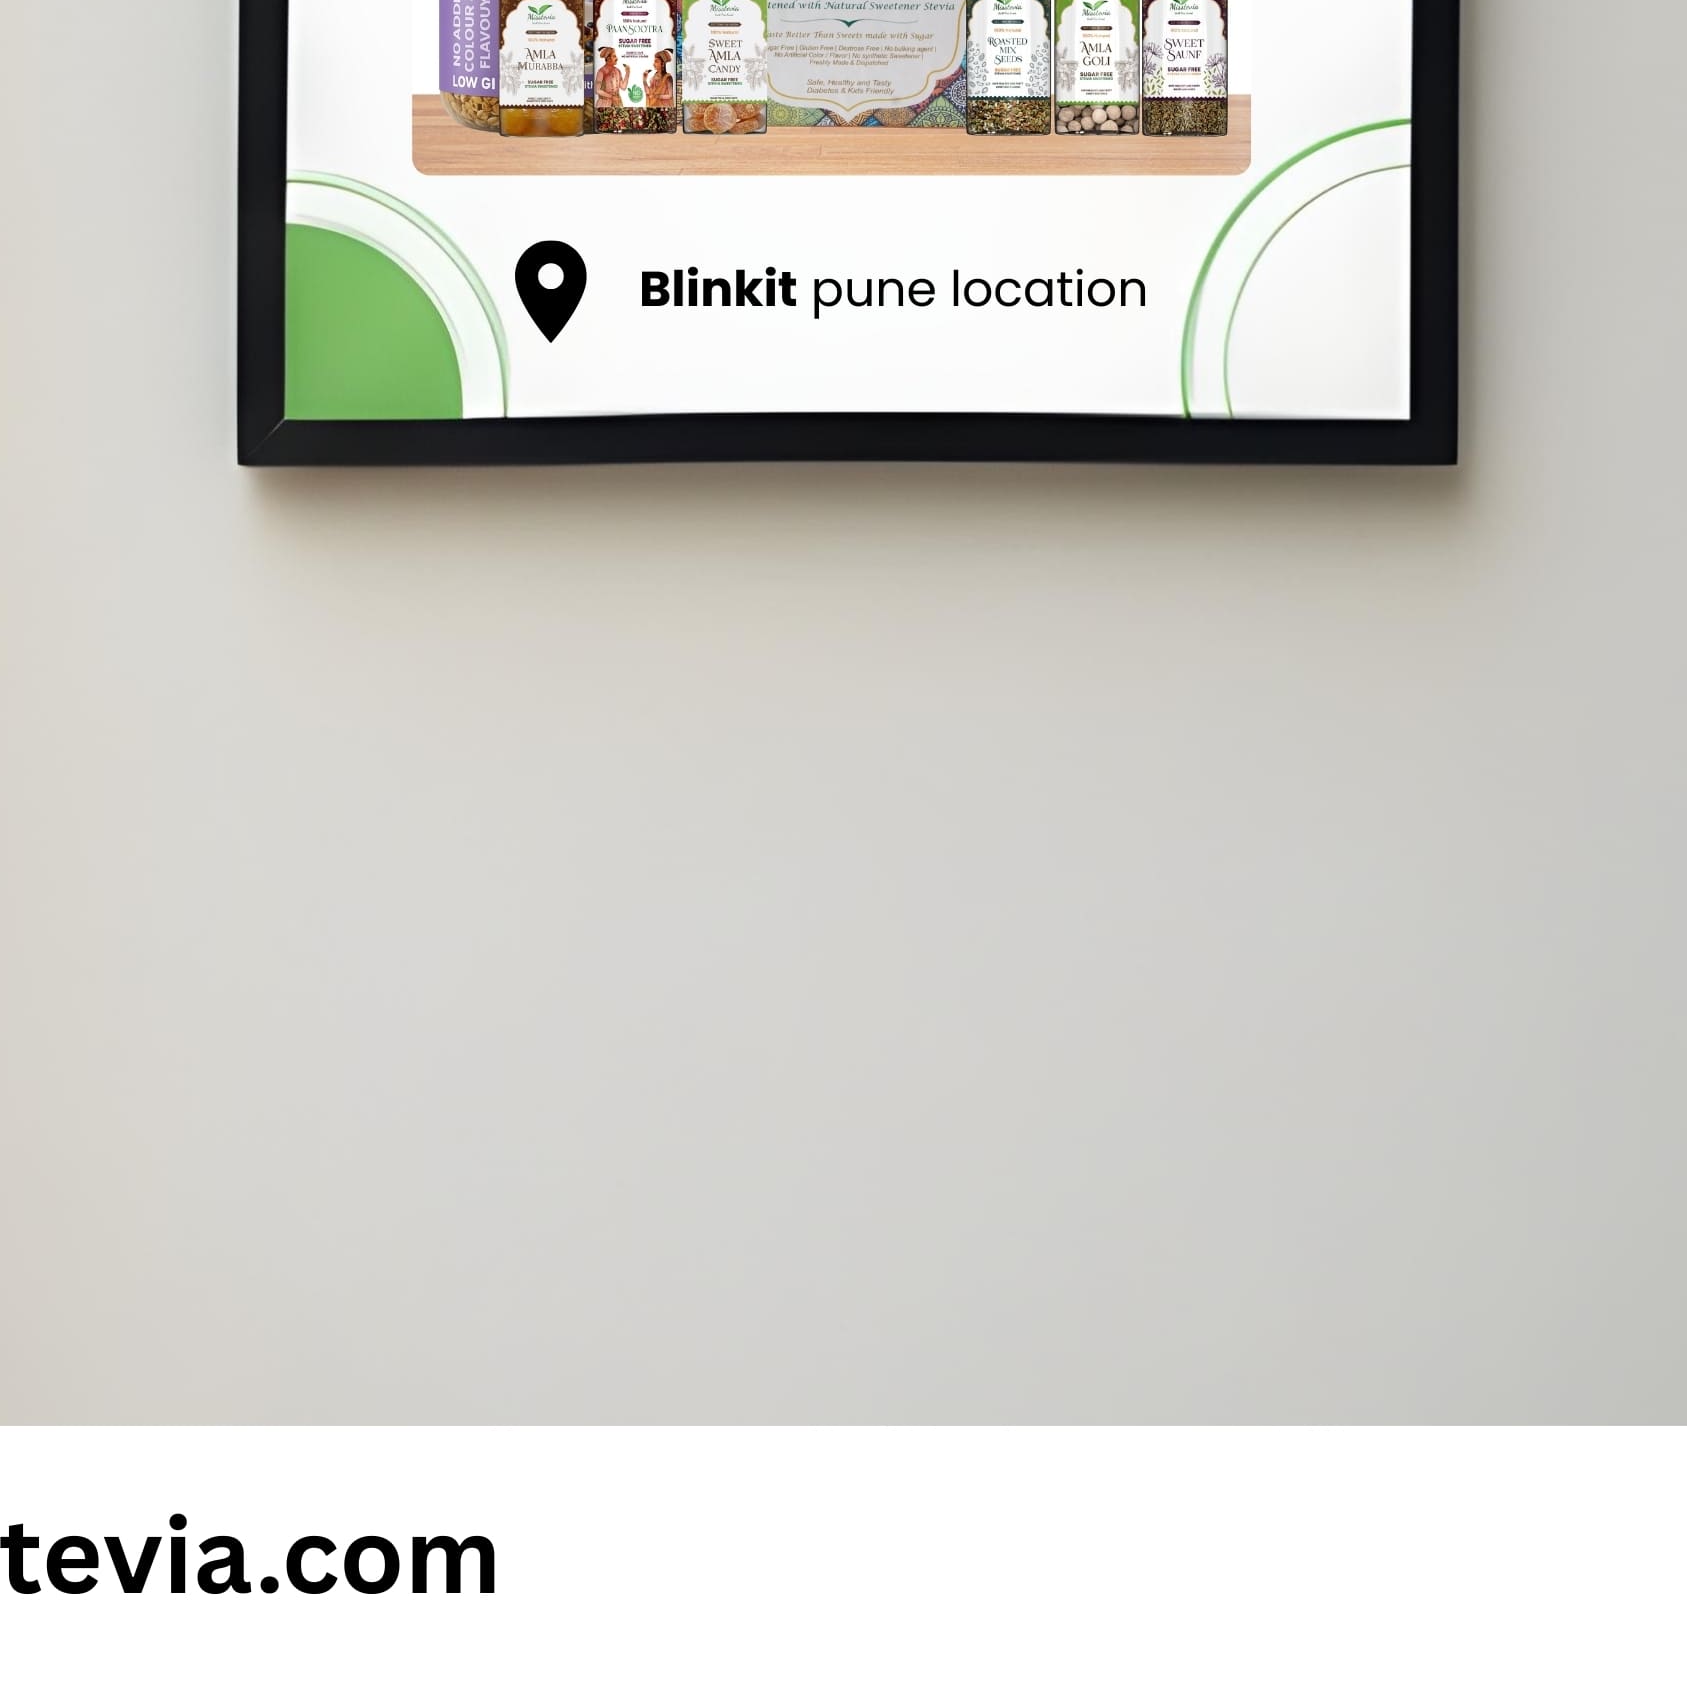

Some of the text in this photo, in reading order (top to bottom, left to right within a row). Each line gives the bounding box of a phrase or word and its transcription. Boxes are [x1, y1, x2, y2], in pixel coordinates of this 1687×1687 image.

[798, 0, 821, 10] with
[824, 0, 866, 10] Natural
[870, 1, 920, 11] Sweetener
[923, 1, 955, 11] Stevia
[464, 4, 475, 73] COLOUR
[708, 39, 743, 48] SWEET
[987, 38, 1028, 47] ROASTED
[1163, 38, 1205, 50] SWEET
[1080, 41, 1112, 55] AMLA
[453, 44, 461, 67] NO
[524, 48, 556, 62] AMLA
[708, 49, 741, 63] AMLA
[994, 55, 1023, 65] SEEDS
[1082, 56, 1110, 66] GOLI
[1167, 50, 1202, 62] SAUNF
[517, 62, 563, 71] MURABBA
[708, 64, 741, 74] CANDY
[452, 74, 496, 90] LOW GI
[642, 266, 1145, 320] Blinkit pune location
